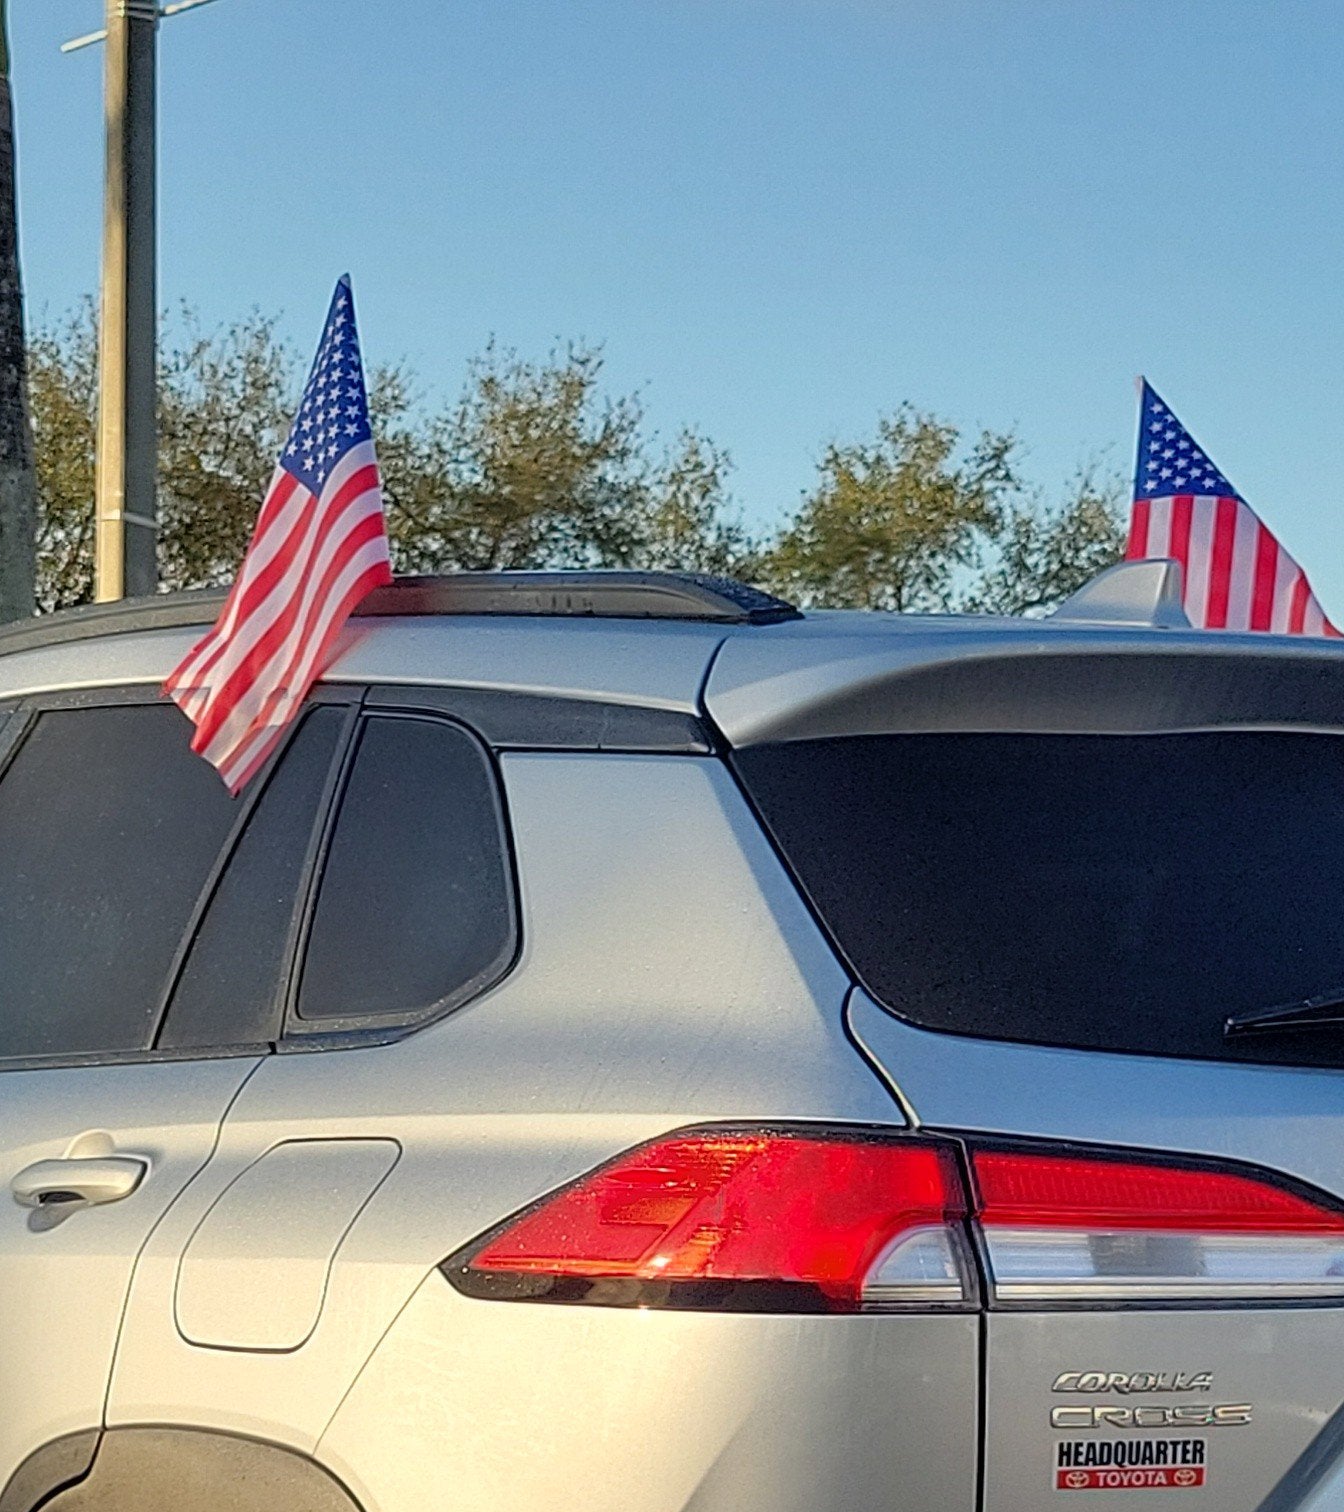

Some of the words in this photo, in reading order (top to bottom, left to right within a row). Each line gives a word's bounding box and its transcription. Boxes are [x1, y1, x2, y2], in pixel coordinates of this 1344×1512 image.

[1051, 1371, 1213, 1394] COROLLA
[1050, 1403, 1253, 1428] CROSS
[1058, 1440, 1205, 1467] HEADQUARTER
[1096, 1470, 1167, 1487] TOYOTA
